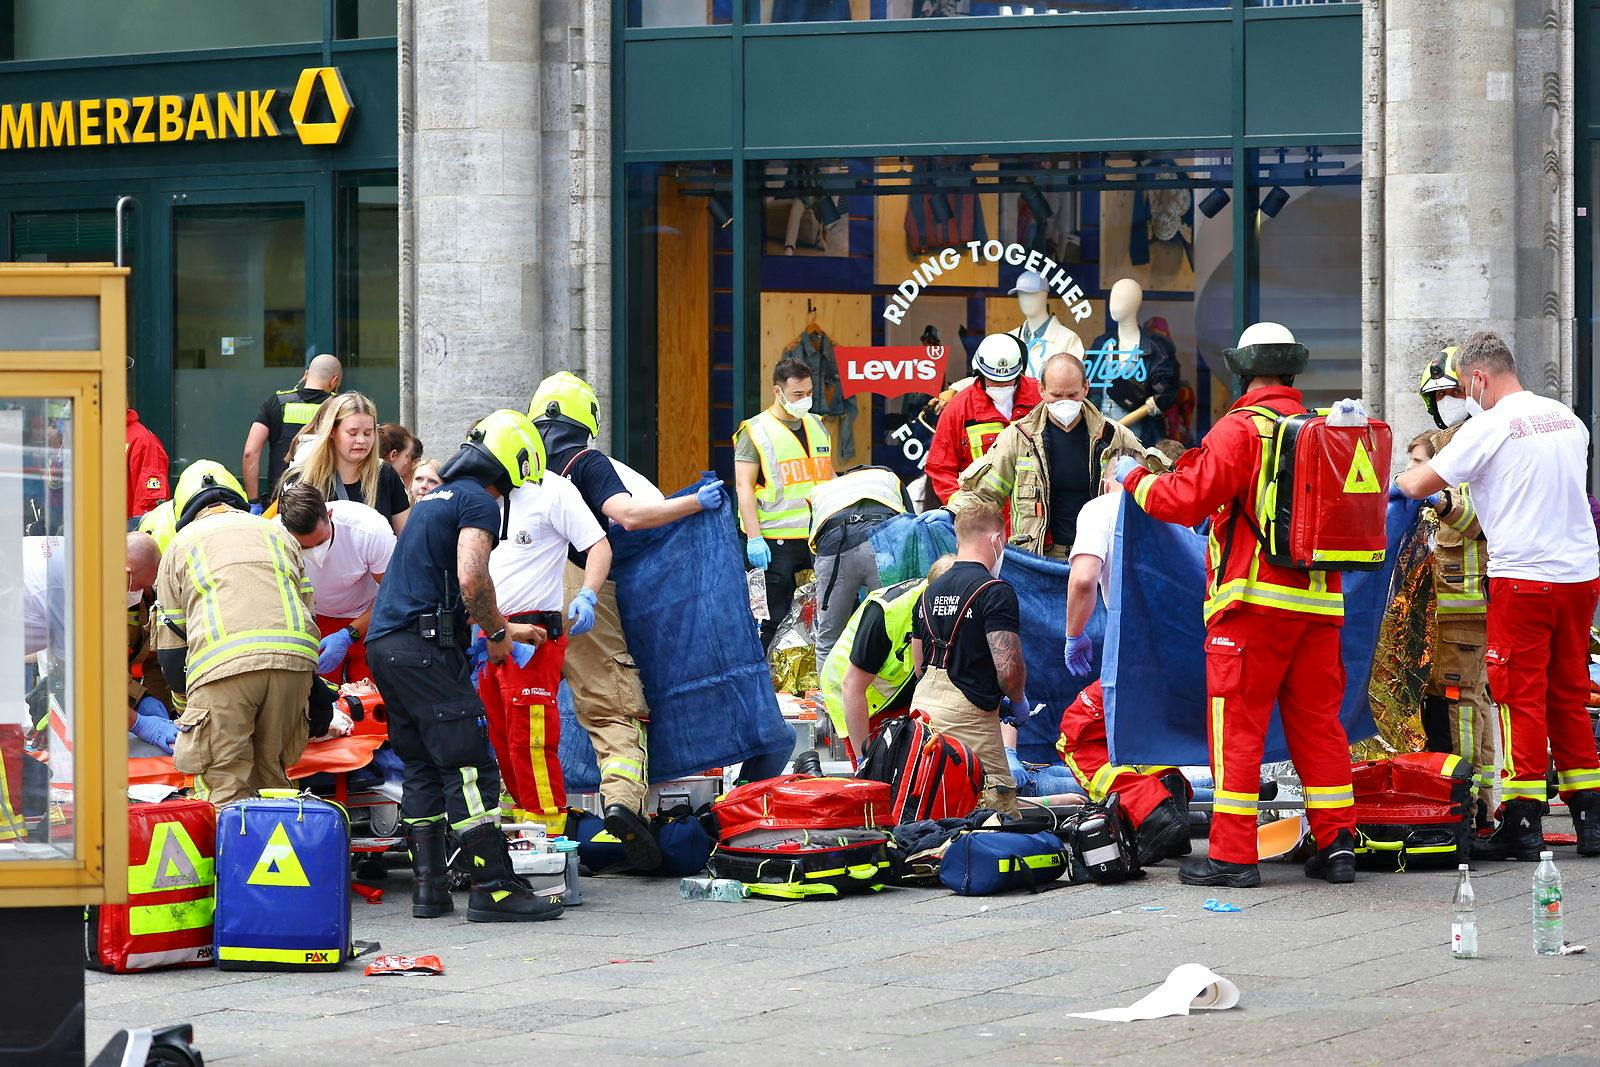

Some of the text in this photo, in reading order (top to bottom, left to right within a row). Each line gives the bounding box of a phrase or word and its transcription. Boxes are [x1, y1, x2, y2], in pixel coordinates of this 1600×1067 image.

[0, 89, 279, 149] MMERZBANK
[883, 240, 1093, 325] RIDING TOGETHER
[197, 946, 214, 959] PAX
[305, 951, 328, 963] PAX
